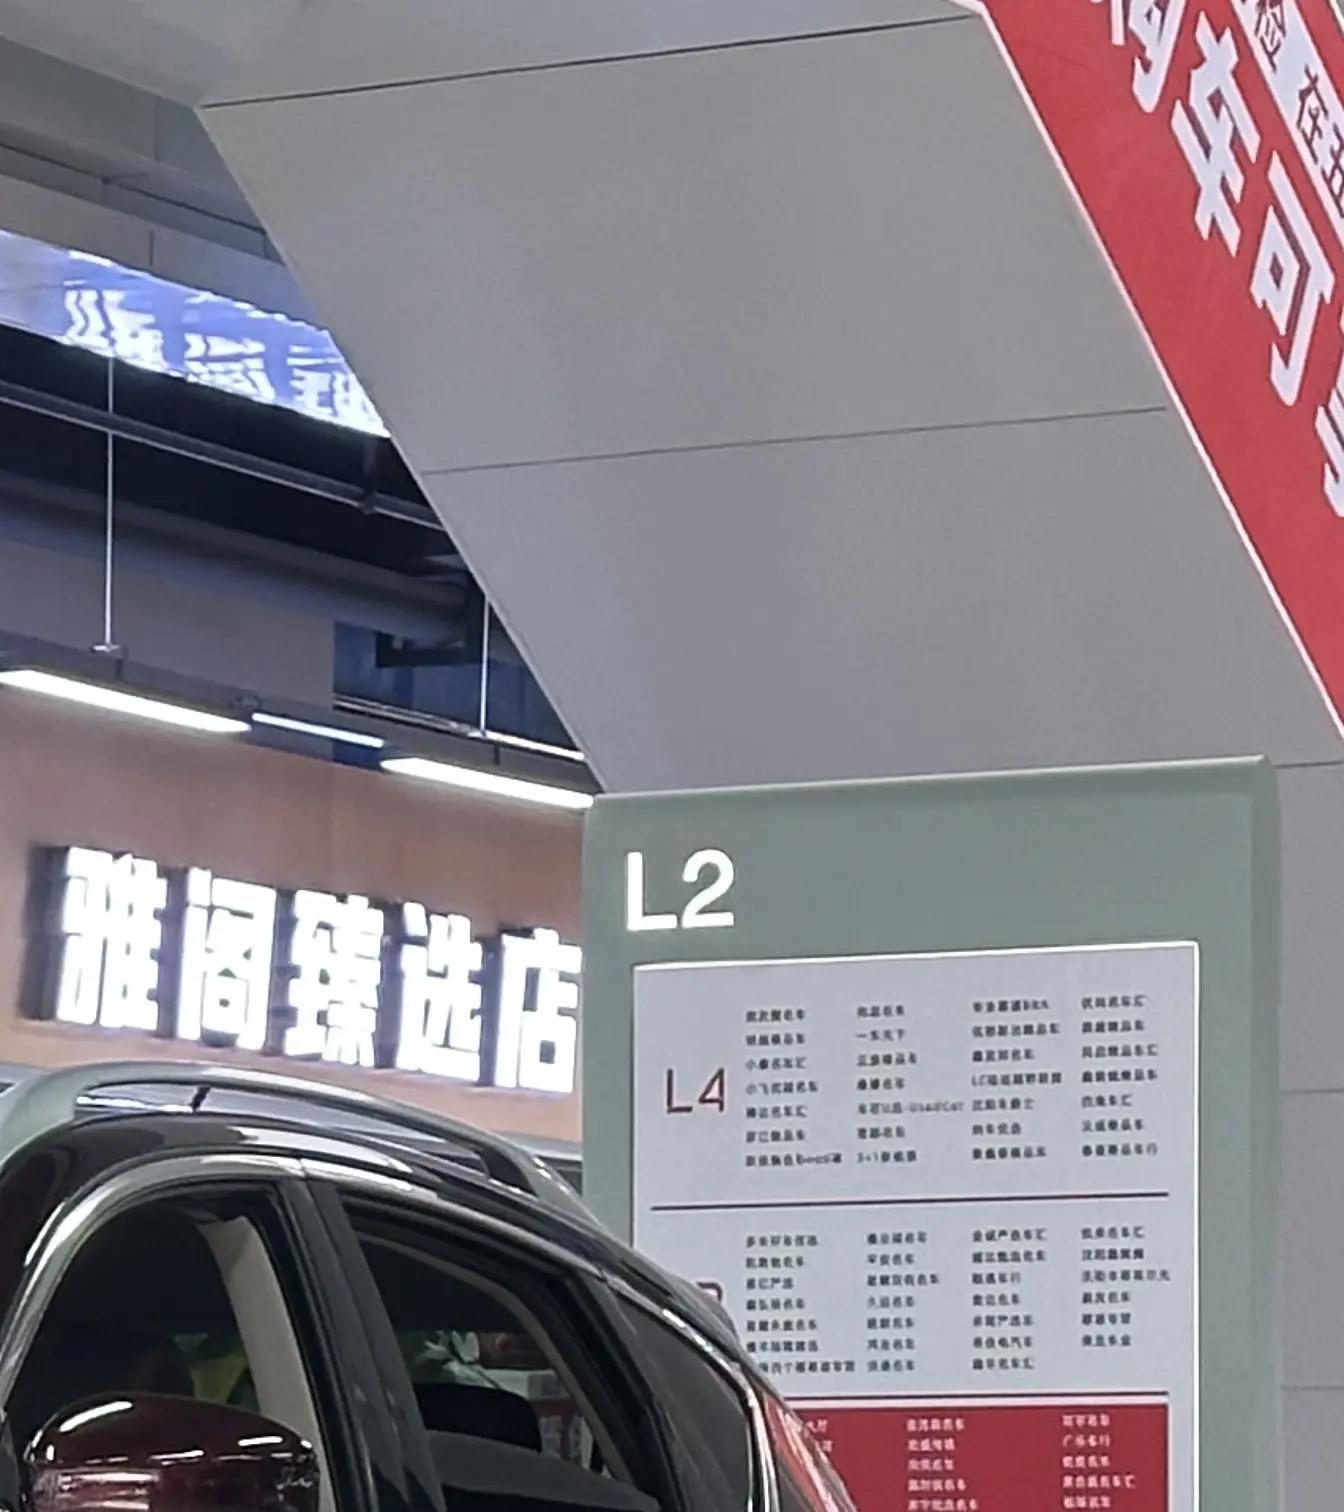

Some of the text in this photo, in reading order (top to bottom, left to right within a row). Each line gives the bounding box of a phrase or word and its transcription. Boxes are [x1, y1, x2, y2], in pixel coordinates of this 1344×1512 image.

[625, 848, 736, 931] L2
[56, 845, 584, 1093] 雅阁臻选店
[665, 1066, 727, 1114] L4
